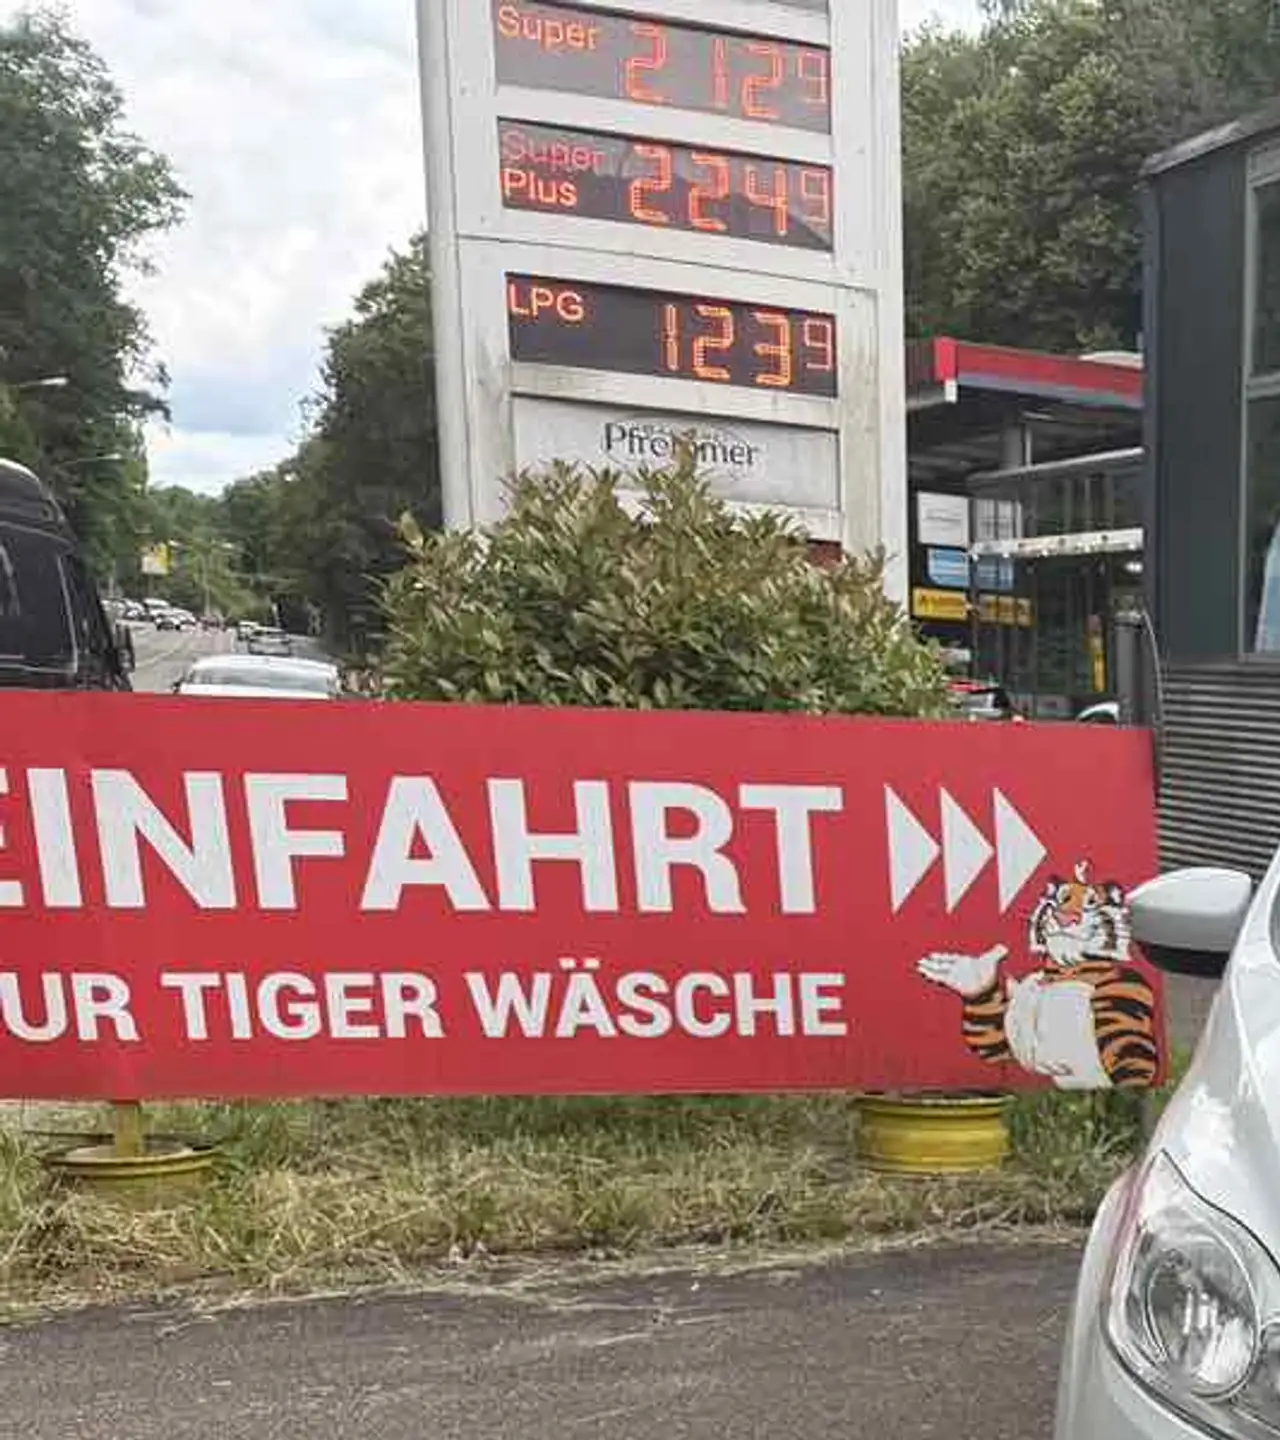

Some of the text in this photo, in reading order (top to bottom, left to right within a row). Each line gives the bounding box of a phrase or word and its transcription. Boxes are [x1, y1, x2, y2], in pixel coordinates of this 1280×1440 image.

[498, 5, 600, 50] Super
[502, 129, 607, 174] Super
[502, 168, 578, 207] Plus
[509, 283, 585, 321] LPG
[0, 766, 844, 914] INFAHRT
[160, 972, 445, 1040] TIGER
[464, 957, 848, 1038] WÄSCHE
